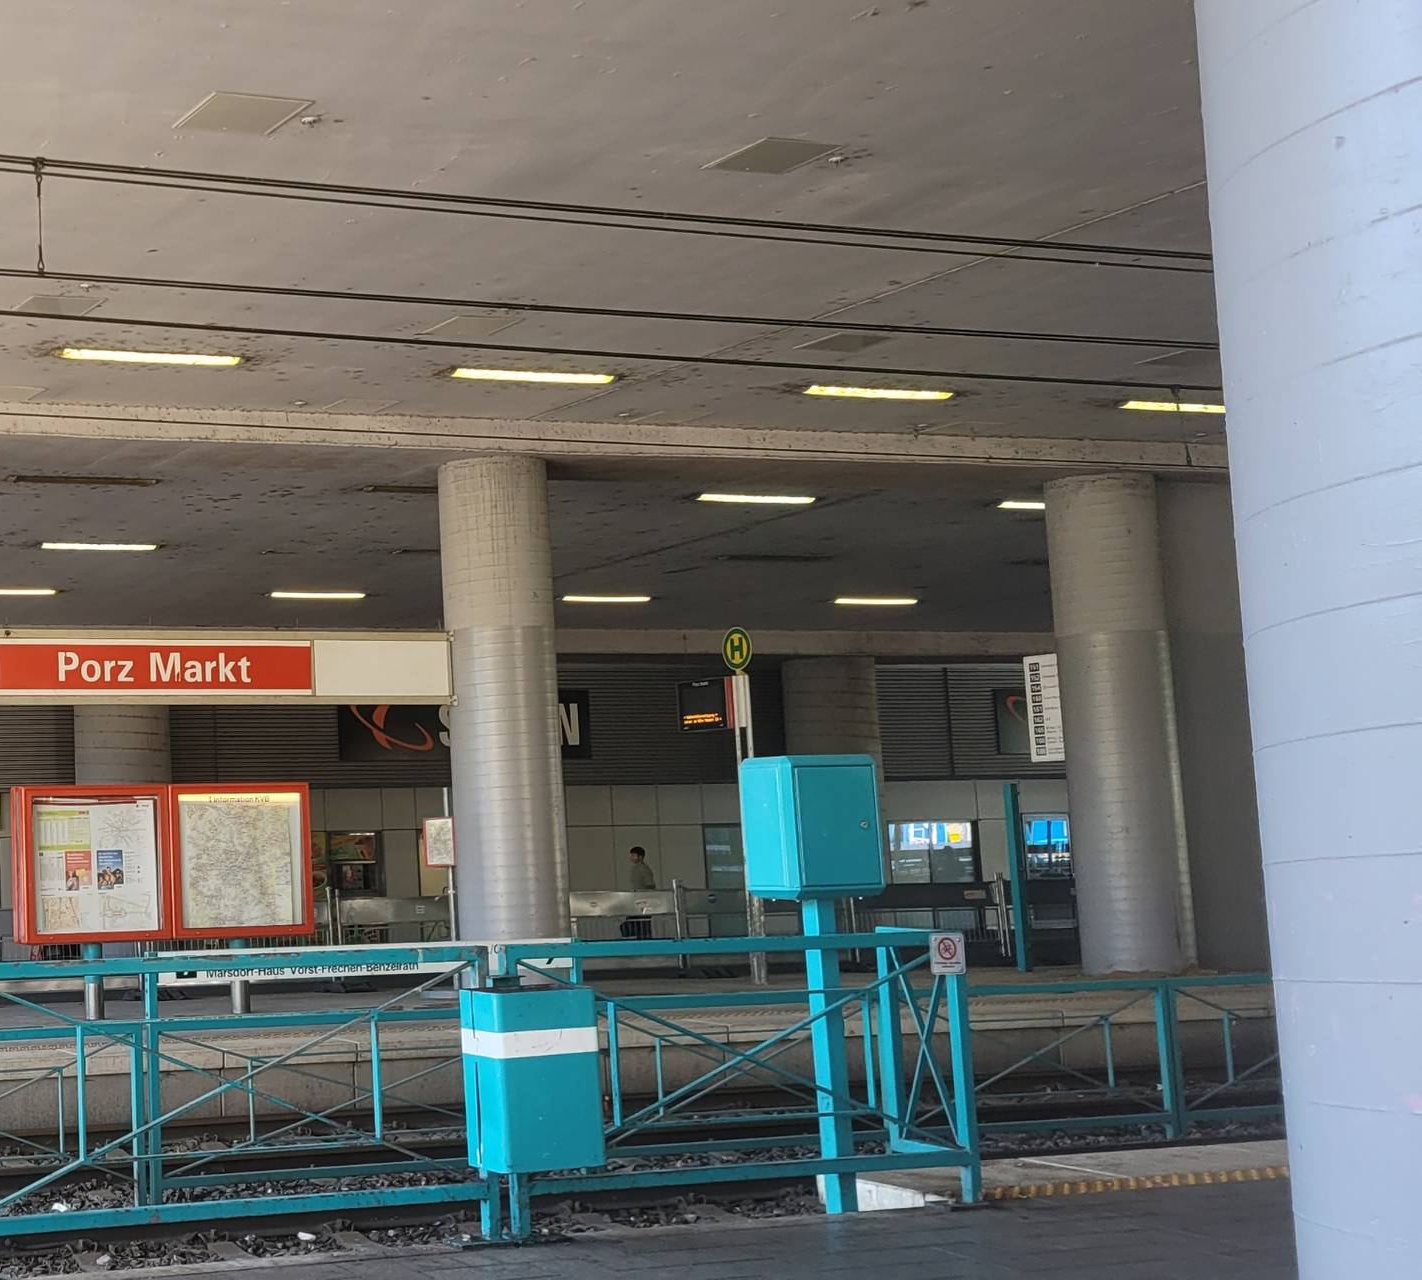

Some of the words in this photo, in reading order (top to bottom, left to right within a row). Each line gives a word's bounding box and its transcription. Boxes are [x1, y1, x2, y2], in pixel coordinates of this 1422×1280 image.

[730, 637, 743, 660] H
[57, 651, 134, 682] Porz
[149, 652, 251, 683] Markt
